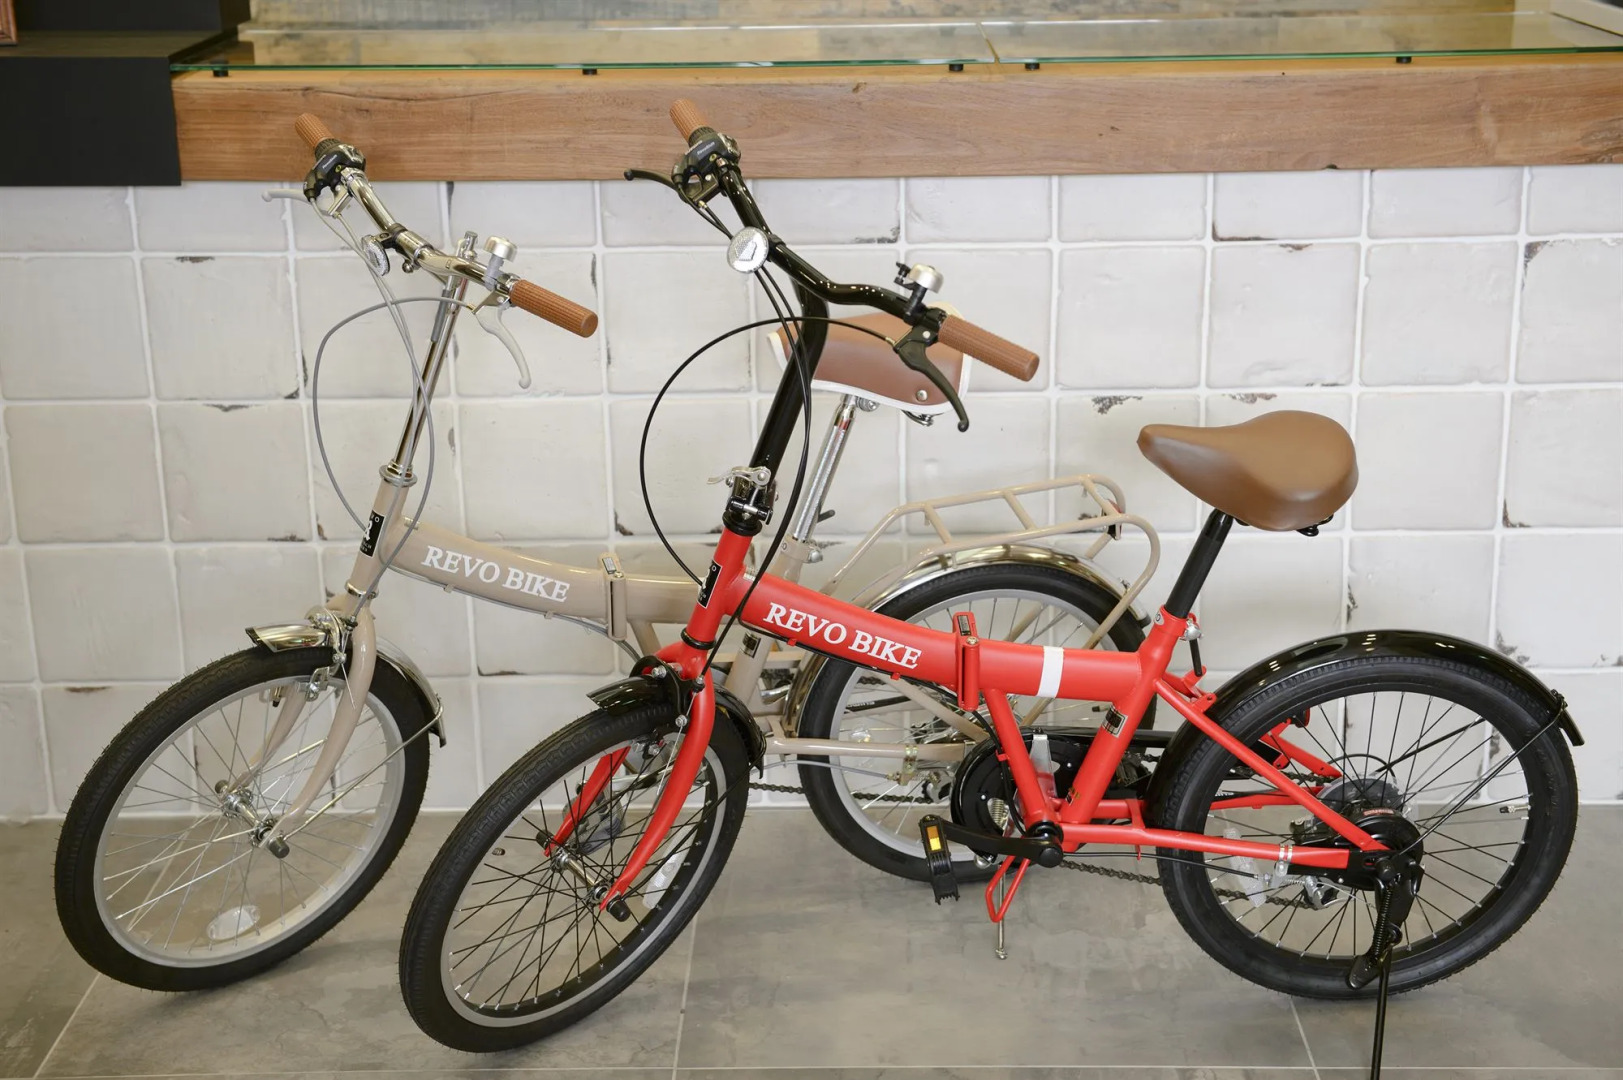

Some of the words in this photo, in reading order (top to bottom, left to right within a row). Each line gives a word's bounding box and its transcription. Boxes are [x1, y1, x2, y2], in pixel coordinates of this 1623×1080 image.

[421, 545, 501, 583] REVO
[502, 567, 570, 603] BIKE
[763, 602, 847, 645] REVO
[848, 630, 922, 670] BIKE
